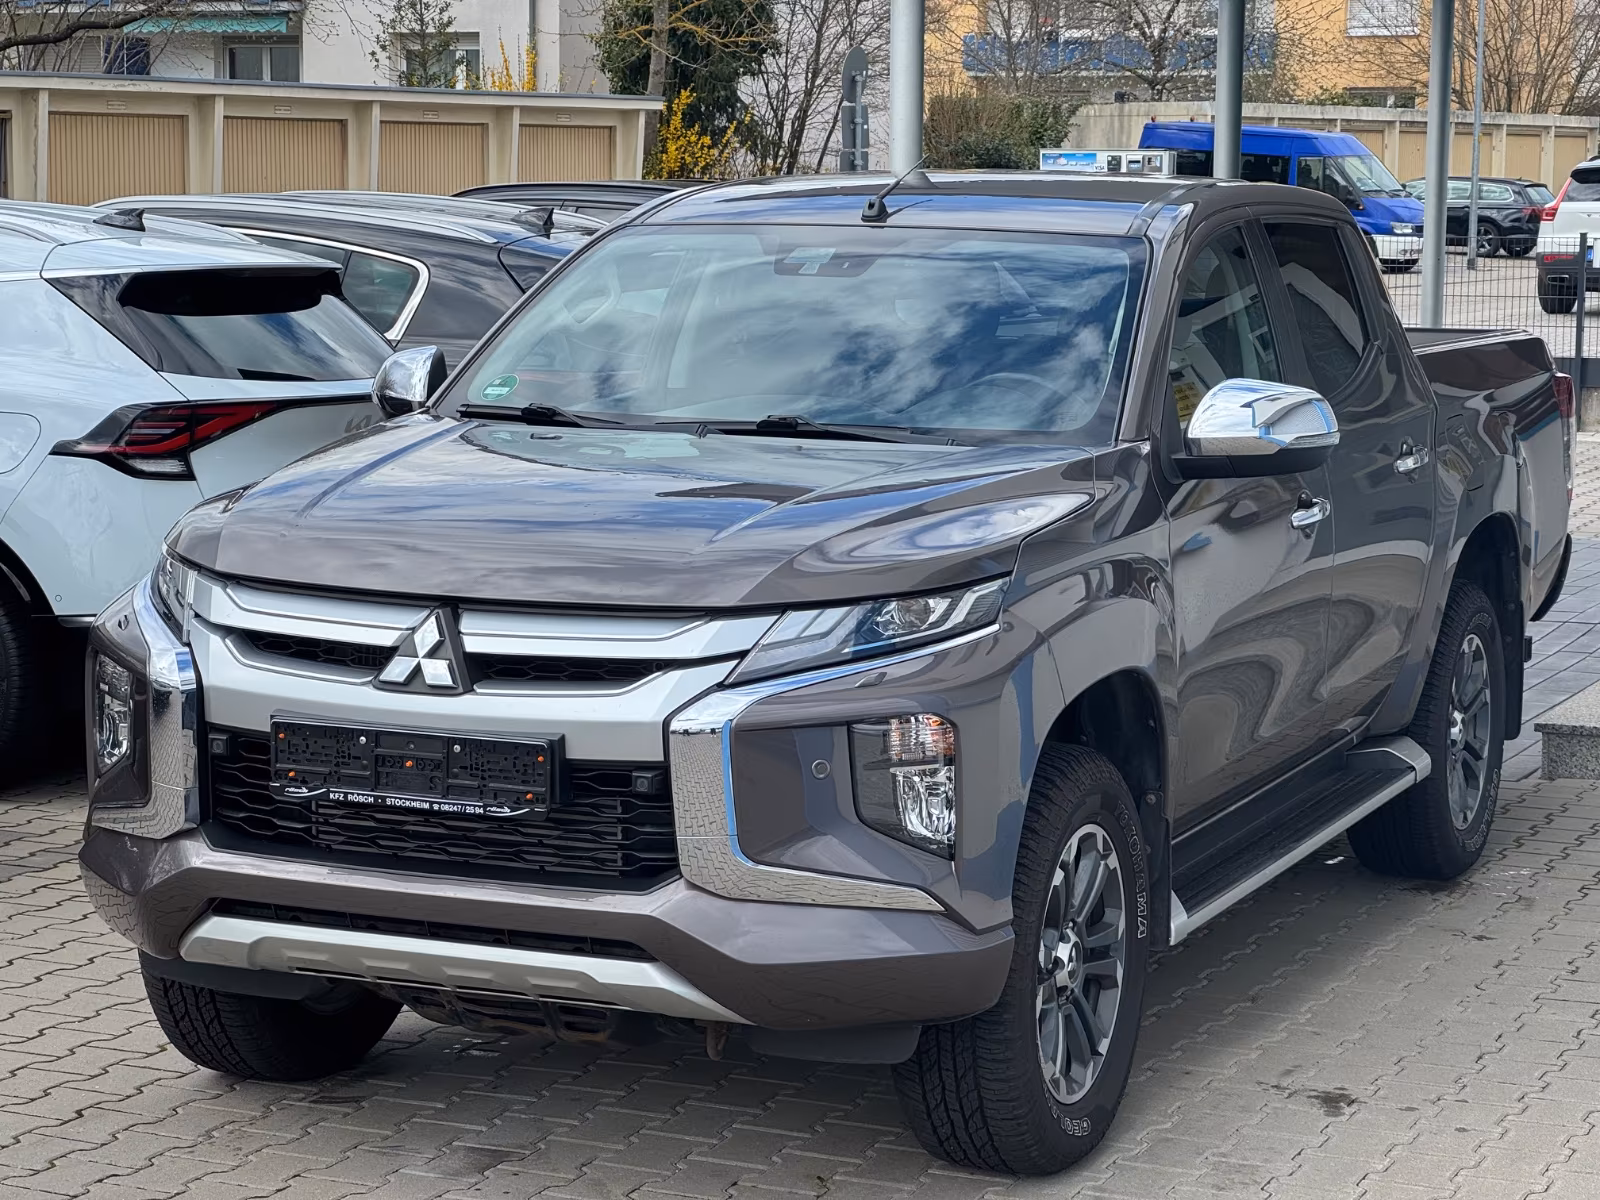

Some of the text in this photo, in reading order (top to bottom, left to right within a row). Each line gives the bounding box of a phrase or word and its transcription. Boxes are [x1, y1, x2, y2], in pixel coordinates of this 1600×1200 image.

[329, 792, 344, 801] KFZ
[347, 793, 374, 803] RÖSCH
[386, 797, 430, 810] STOCKHEIM
[1114, 800, 1148, 939] YOKOHAMA
